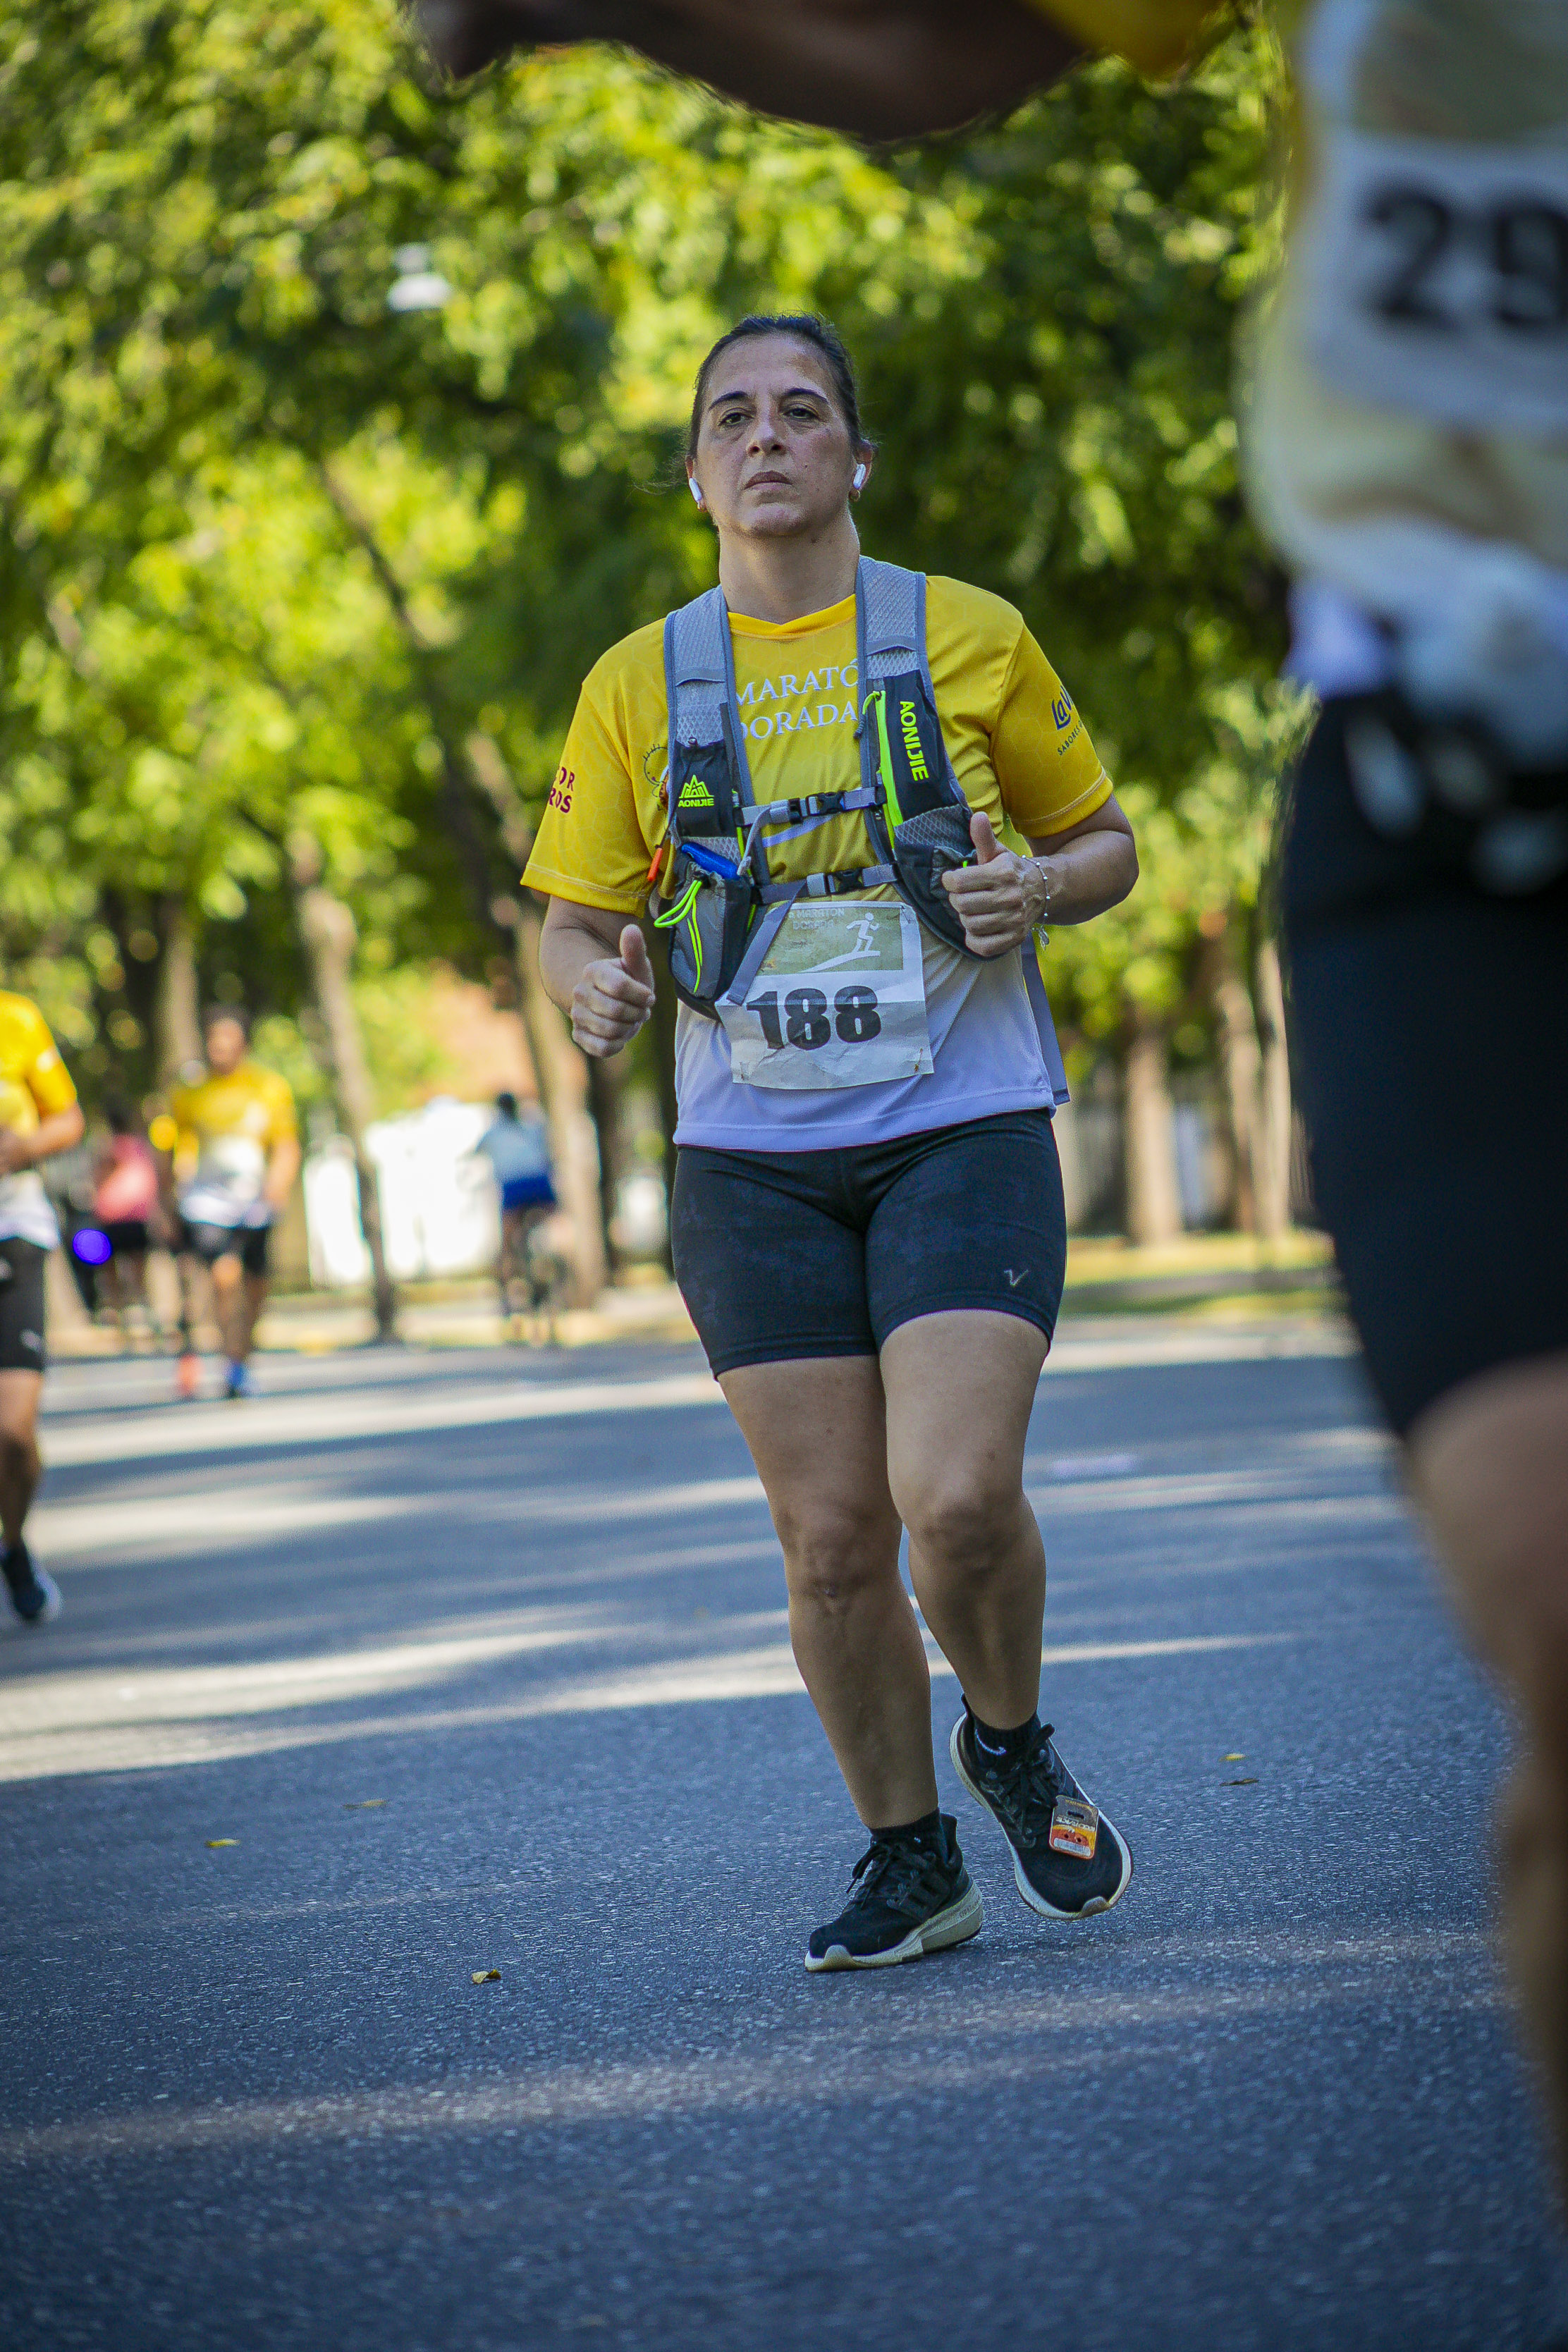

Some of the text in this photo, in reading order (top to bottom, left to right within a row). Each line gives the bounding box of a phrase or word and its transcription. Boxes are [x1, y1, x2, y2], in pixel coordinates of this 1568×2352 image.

[900, 701, 929, 781] AONIJIE
[678, 798, 714, 808] AONIJIE
[746, 985, 881, 1051] 188
